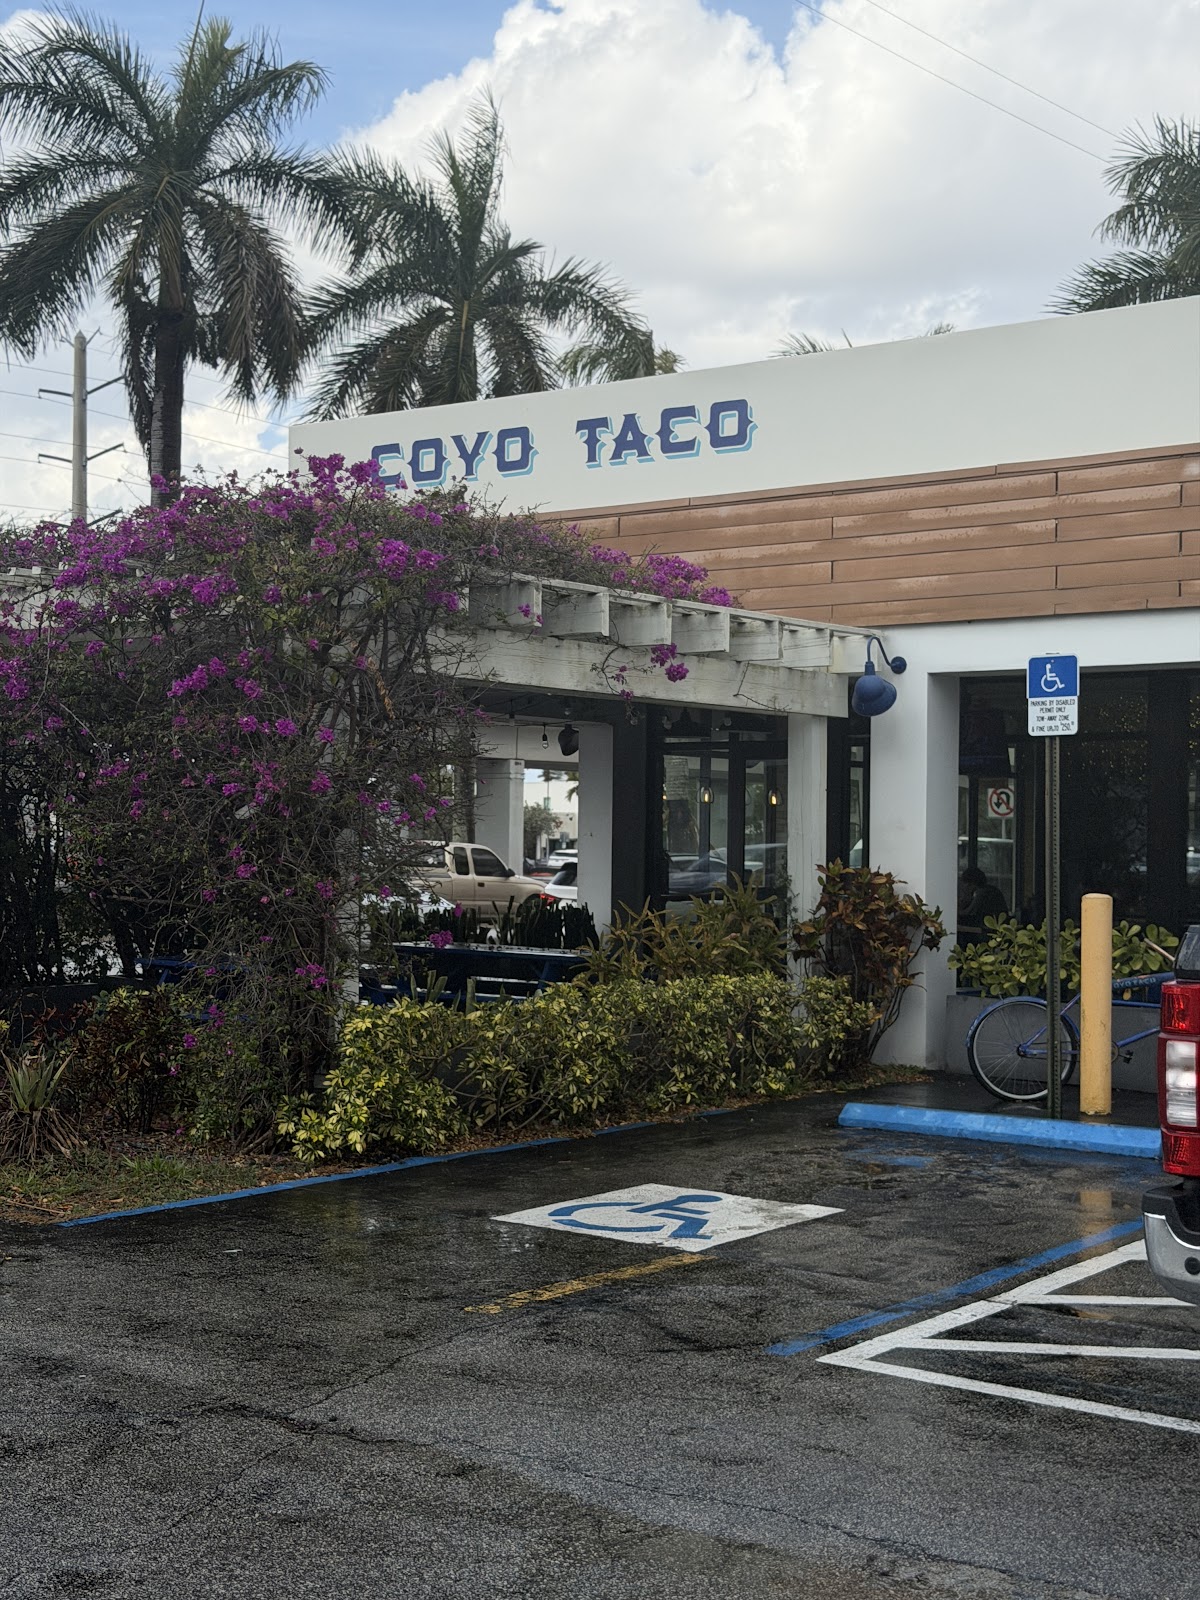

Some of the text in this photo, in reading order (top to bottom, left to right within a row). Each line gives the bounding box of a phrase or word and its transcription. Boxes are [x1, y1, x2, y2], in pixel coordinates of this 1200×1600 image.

[371, 399, 759, 491] COYO TACO
[1113, 980, 1131, 989] OYO
